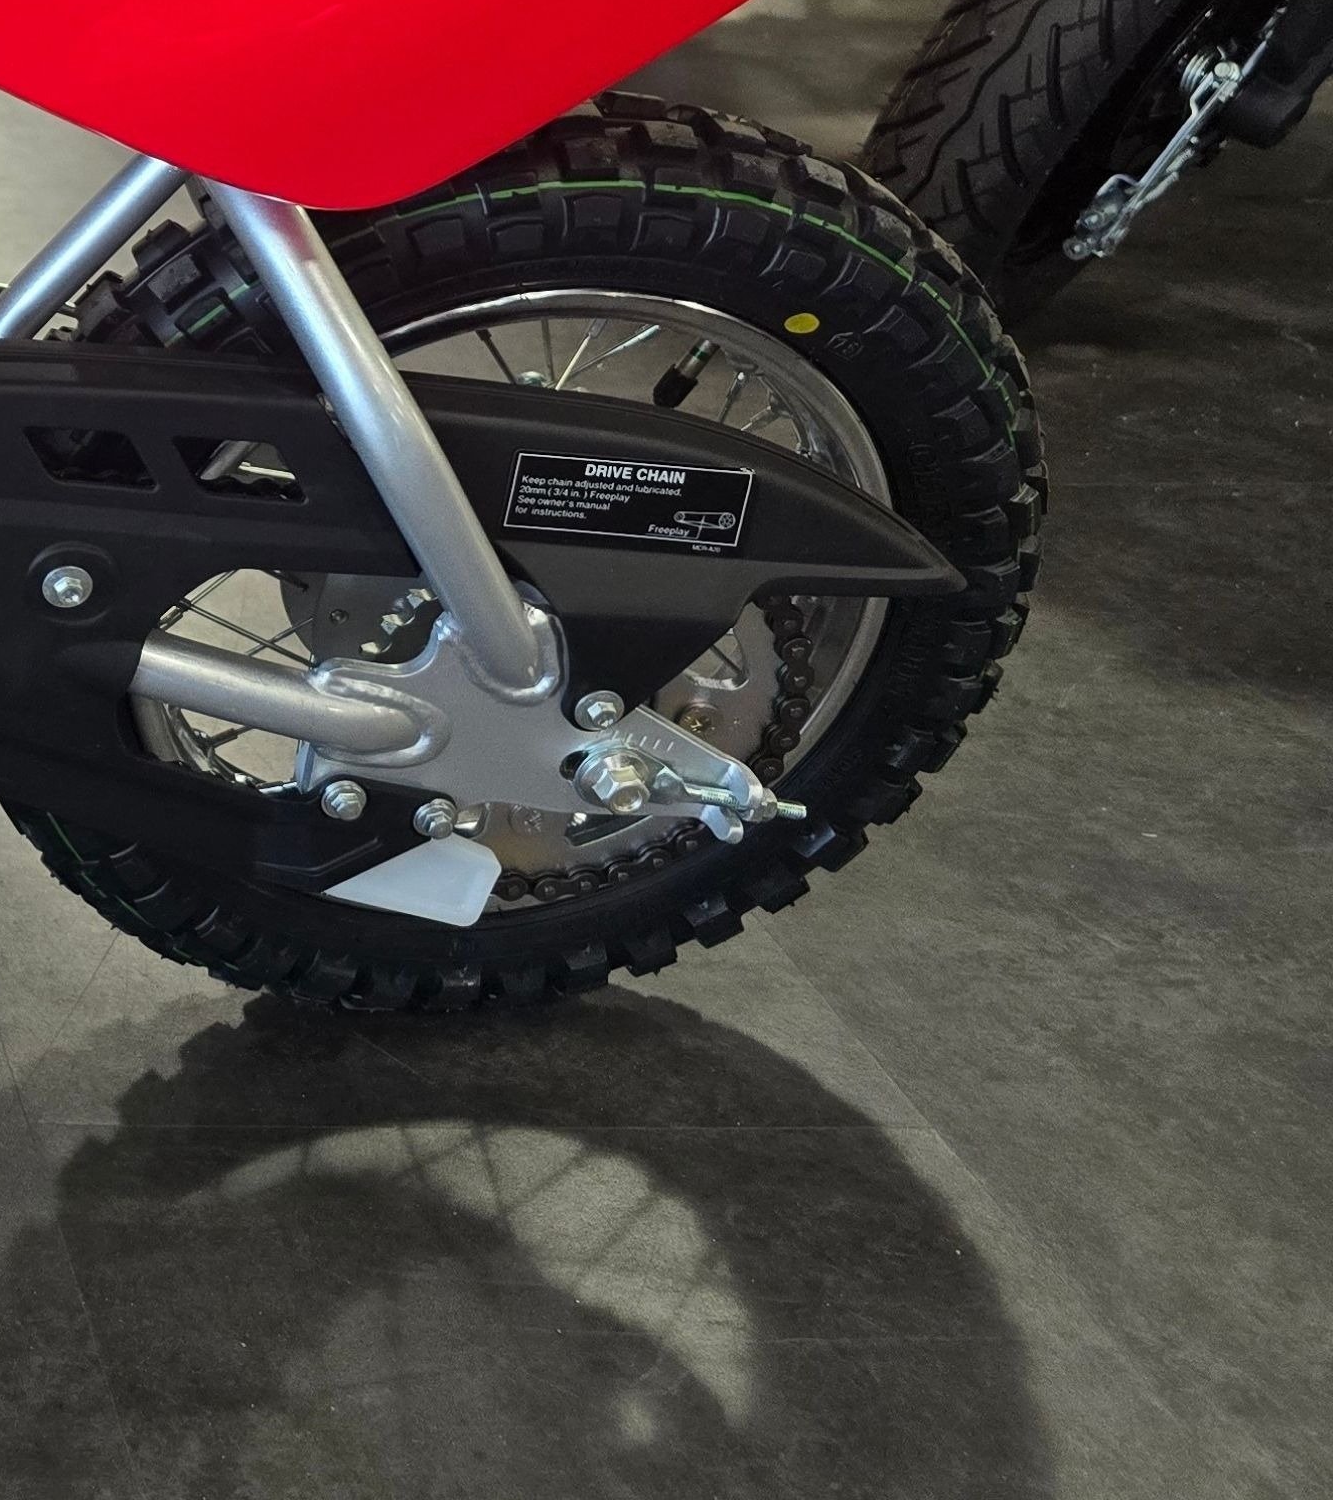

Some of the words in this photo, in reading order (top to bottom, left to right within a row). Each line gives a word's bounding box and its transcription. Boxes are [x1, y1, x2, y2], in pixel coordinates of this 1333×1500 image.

[584, 463, 633, 480] DRIVE
[636, 467, 686, 484] CHAIN
[519, 485, 547, 496] 20mm
[552, 487, 569, 497] 3/4
[590, 490, 630, 503] Freeplay
[521, 475, 546, 487] Keep
[547, 477, 573, 488] chain
[574, 479, 615, 492] adjusted
[615, 481, 633, 492] and
[635, 484, 682, 497] lubricated.
[517, 495, 536, 505] See
[576, 500, 610, 510] manual
[515, 505, 528, 515] for
[531, 507, 588, 519] instructions.
[647, 524, 690, 537] Freeplay
